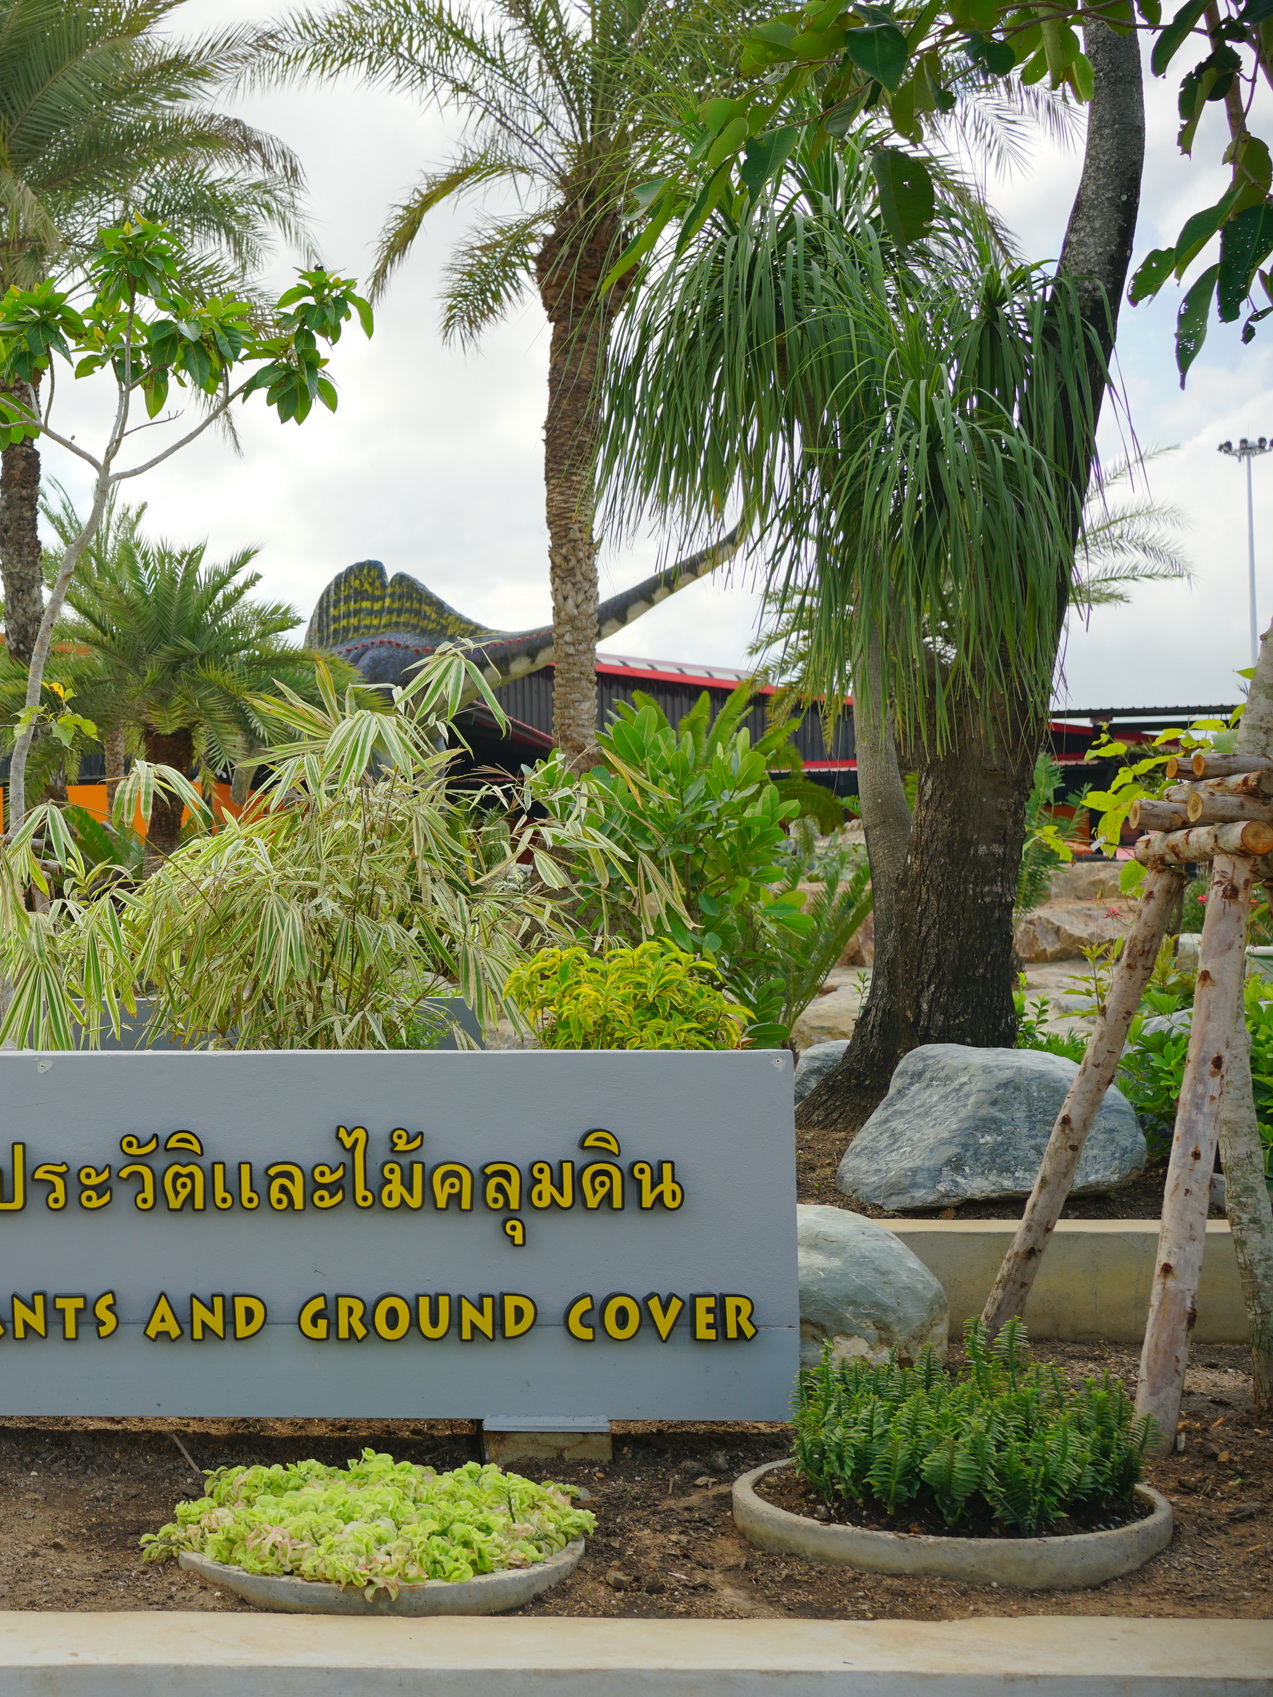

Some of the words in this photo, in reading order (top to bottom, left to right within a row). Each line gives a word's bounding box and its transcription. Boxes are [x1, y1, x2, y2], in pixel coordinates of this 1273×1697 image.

[144, 1292, 268, 1342] AND
[298, 1292, 537, 1343] GROUND
[565, 1293, 760, 1343] COVER
